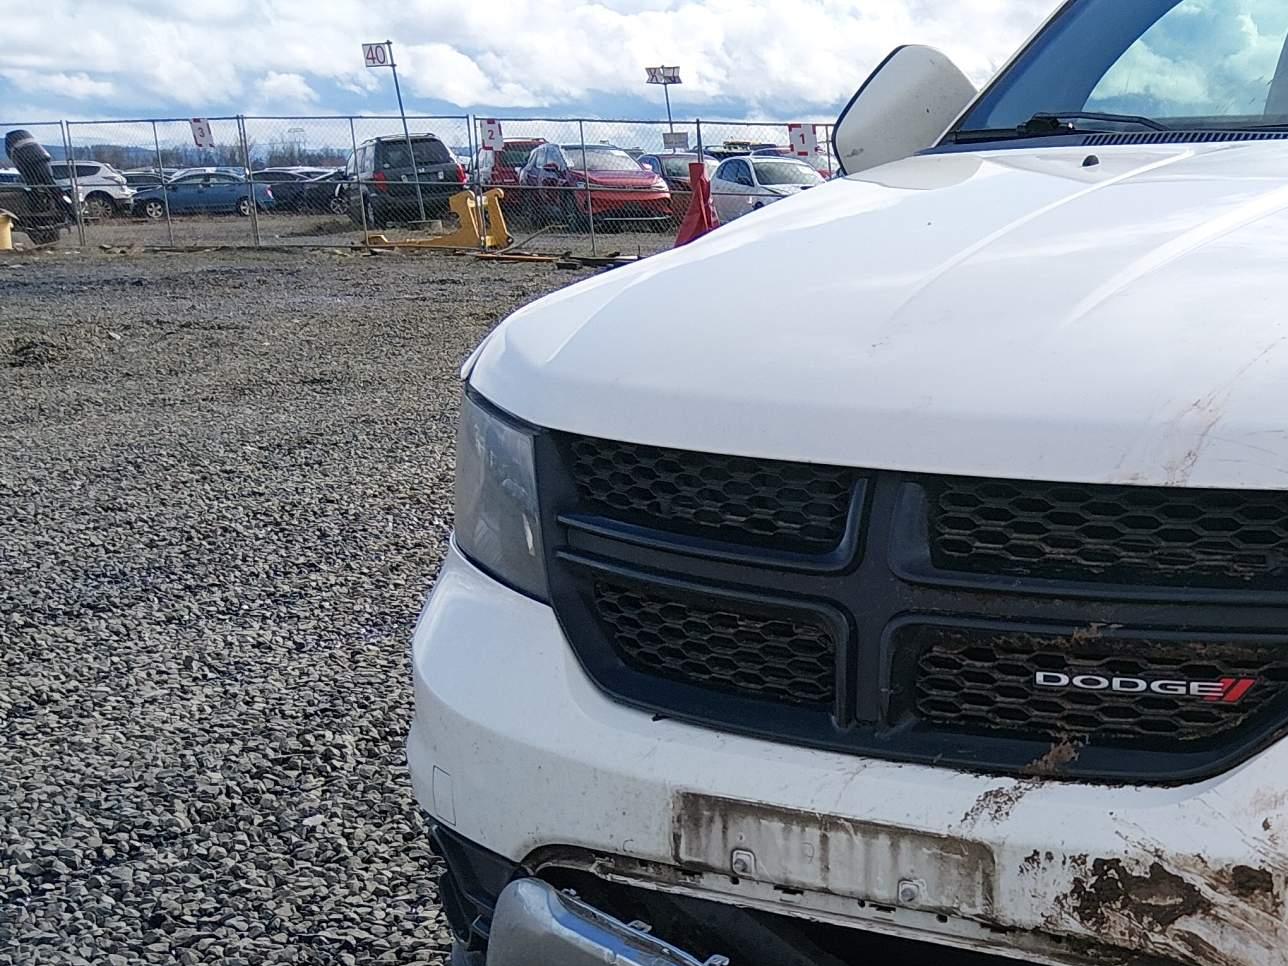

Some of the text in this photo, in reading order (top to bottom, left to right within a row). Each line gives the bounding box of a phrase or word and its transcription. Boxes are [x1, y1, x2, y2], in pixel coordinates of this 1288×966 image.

[366, 45, 386, 64] 40
[197, 127, 205, 138] 3
[487, 129, 496, 140] 2
[799, 133, 806, 145] 1
[1035, 671, 1225, 697] DODGE
